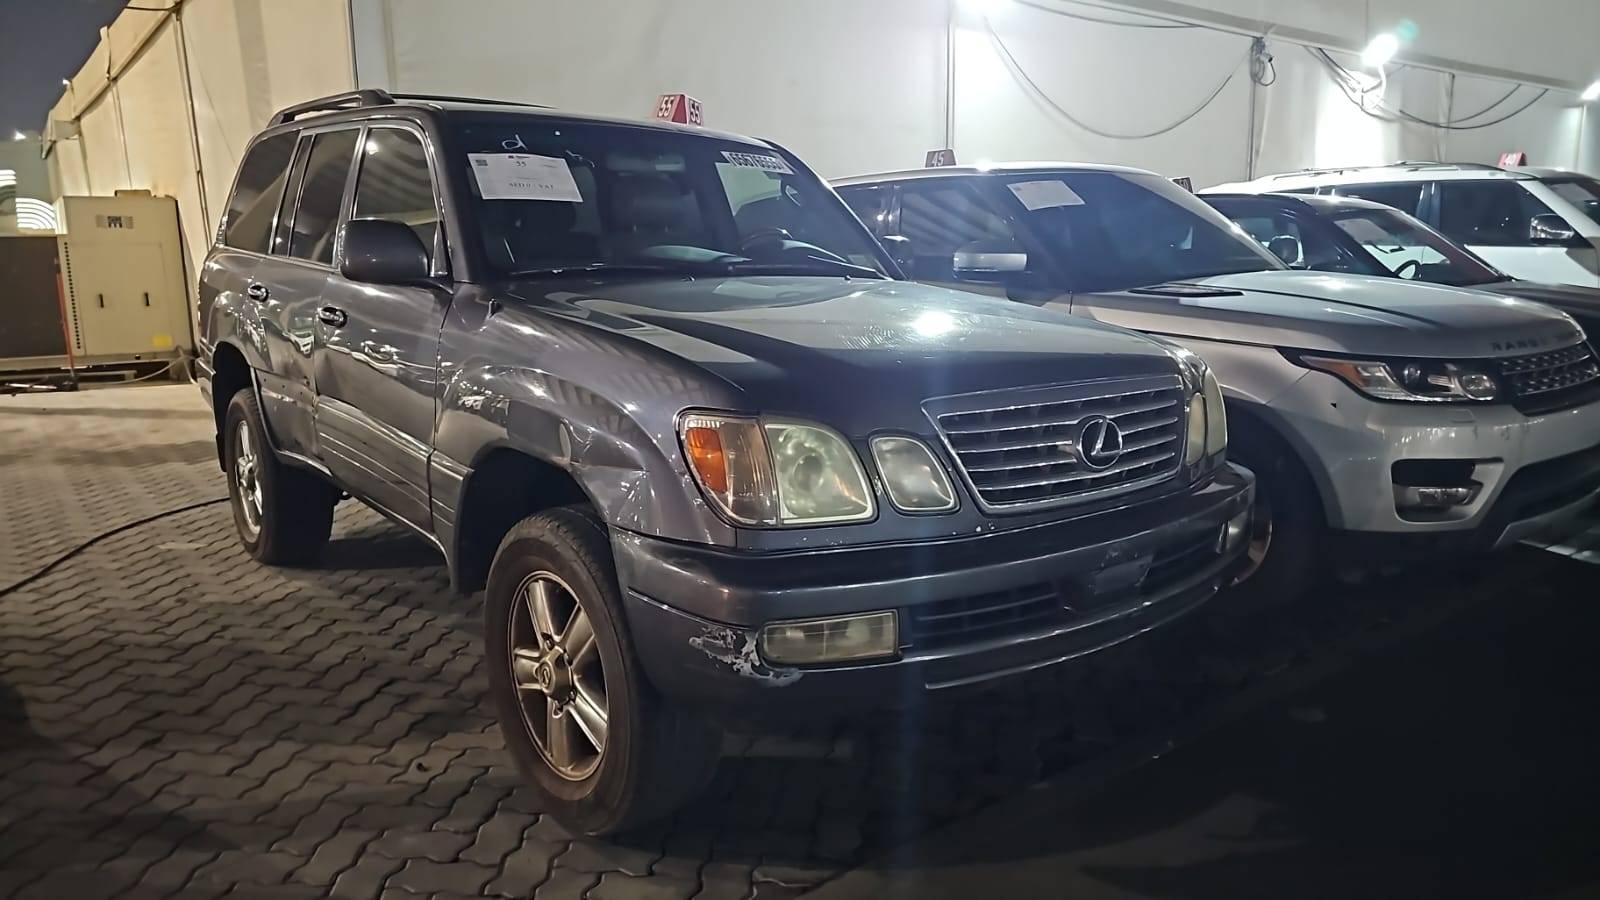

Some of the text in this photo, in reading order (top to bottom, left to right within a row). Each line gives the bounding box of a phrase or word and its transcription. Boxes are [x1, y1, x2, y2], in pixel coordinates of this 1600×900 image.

[658, 96, 675, 117] 55
[689, 99, 701, 124] 55
[931, 151, 945, 167] 45
